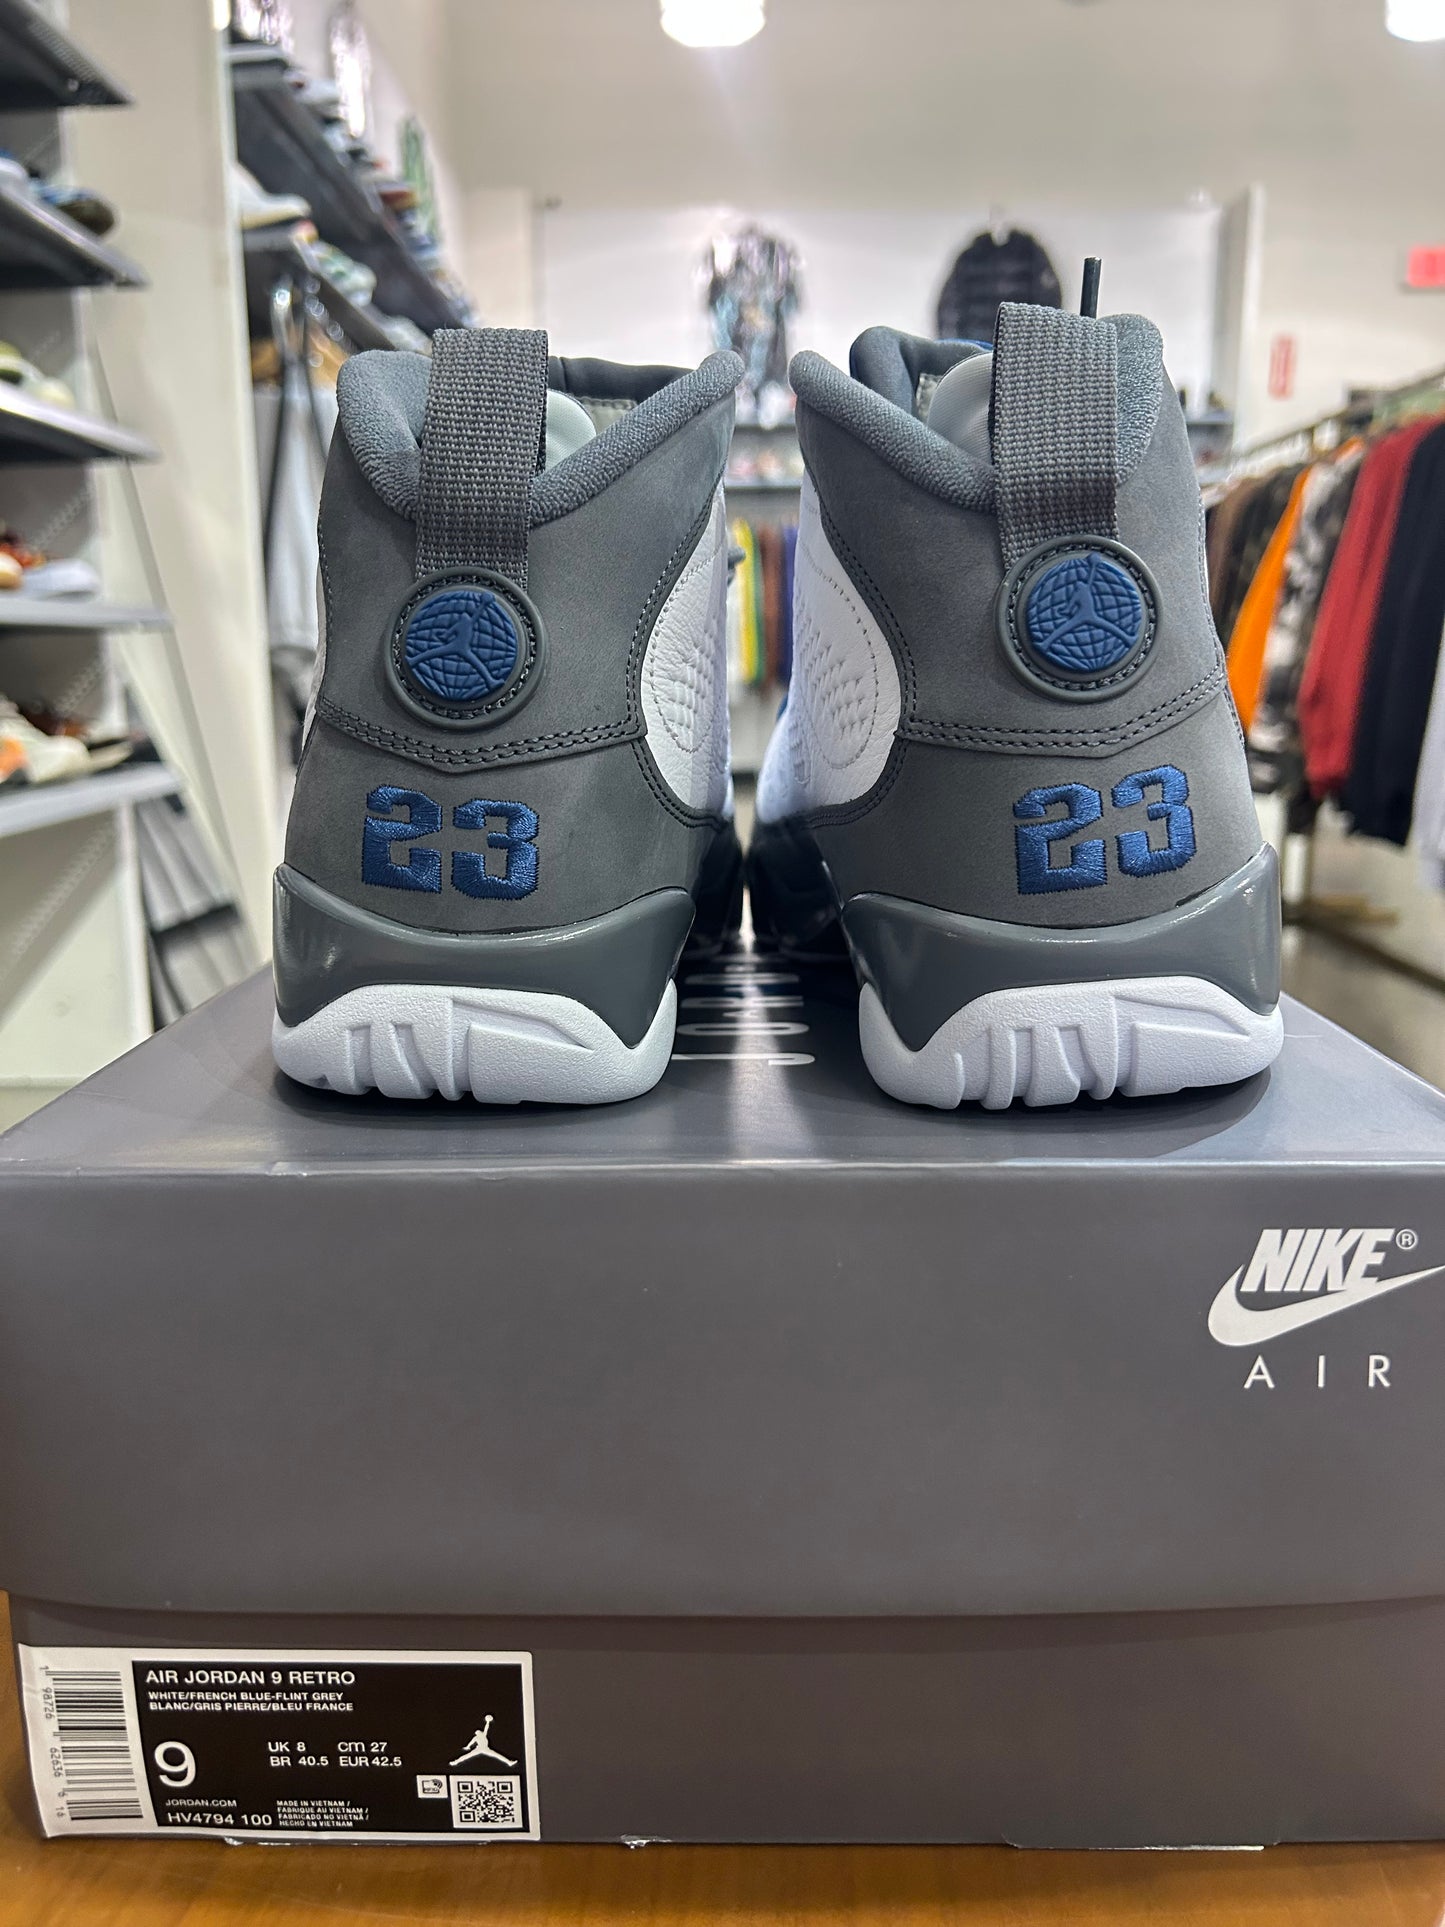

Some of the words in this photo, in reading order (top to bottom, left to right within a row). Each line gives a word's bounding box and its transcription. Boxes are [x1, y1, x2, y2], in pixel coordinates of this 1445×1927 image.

[1013, 764, 1197, 895] 23
[362, 785, 540, 900] 23
[1243, 1355, 1391, 1389] AIR
[146, 1670, 179, 1684] AIR
[184, 1670, 265, 1684] JORDAN
[271, 1671, 282, 1684] 9
[289, 1671, 355, 1684] RETRO
[148, 1691, 237, 1700] WHITE/FRENCH
[240, 1692, 308, 1700] BLUE-FLINT
[312, 1692, 344, 1700] GREY
[150, 1702, 222, 1711] BLANC/GRIS
[225, 1702, 303, 1711] PIERRE/BLEU
[306, 1702, 354, 1711] FRANCE
[42, 1687, 55, 1720] 98726
[49, 1747, 63, 1778] 62636
[268, 1742, 290, 1752] UK
[296, 1742, 306, 1752] 8
[371, 1742, 388, 1752] 27
[153, 1741, 197, 1787] 9
[270, 1756, 291, 1767] BR
[298, 1756, 329, 1766] 40.5
[339, 1756, 369, 1767] EUR
[372, 1756, 402, 1767] 42.5
[167, 1812, 235, 1825] HV4794
[241, 1814, 272, 1826] 100
